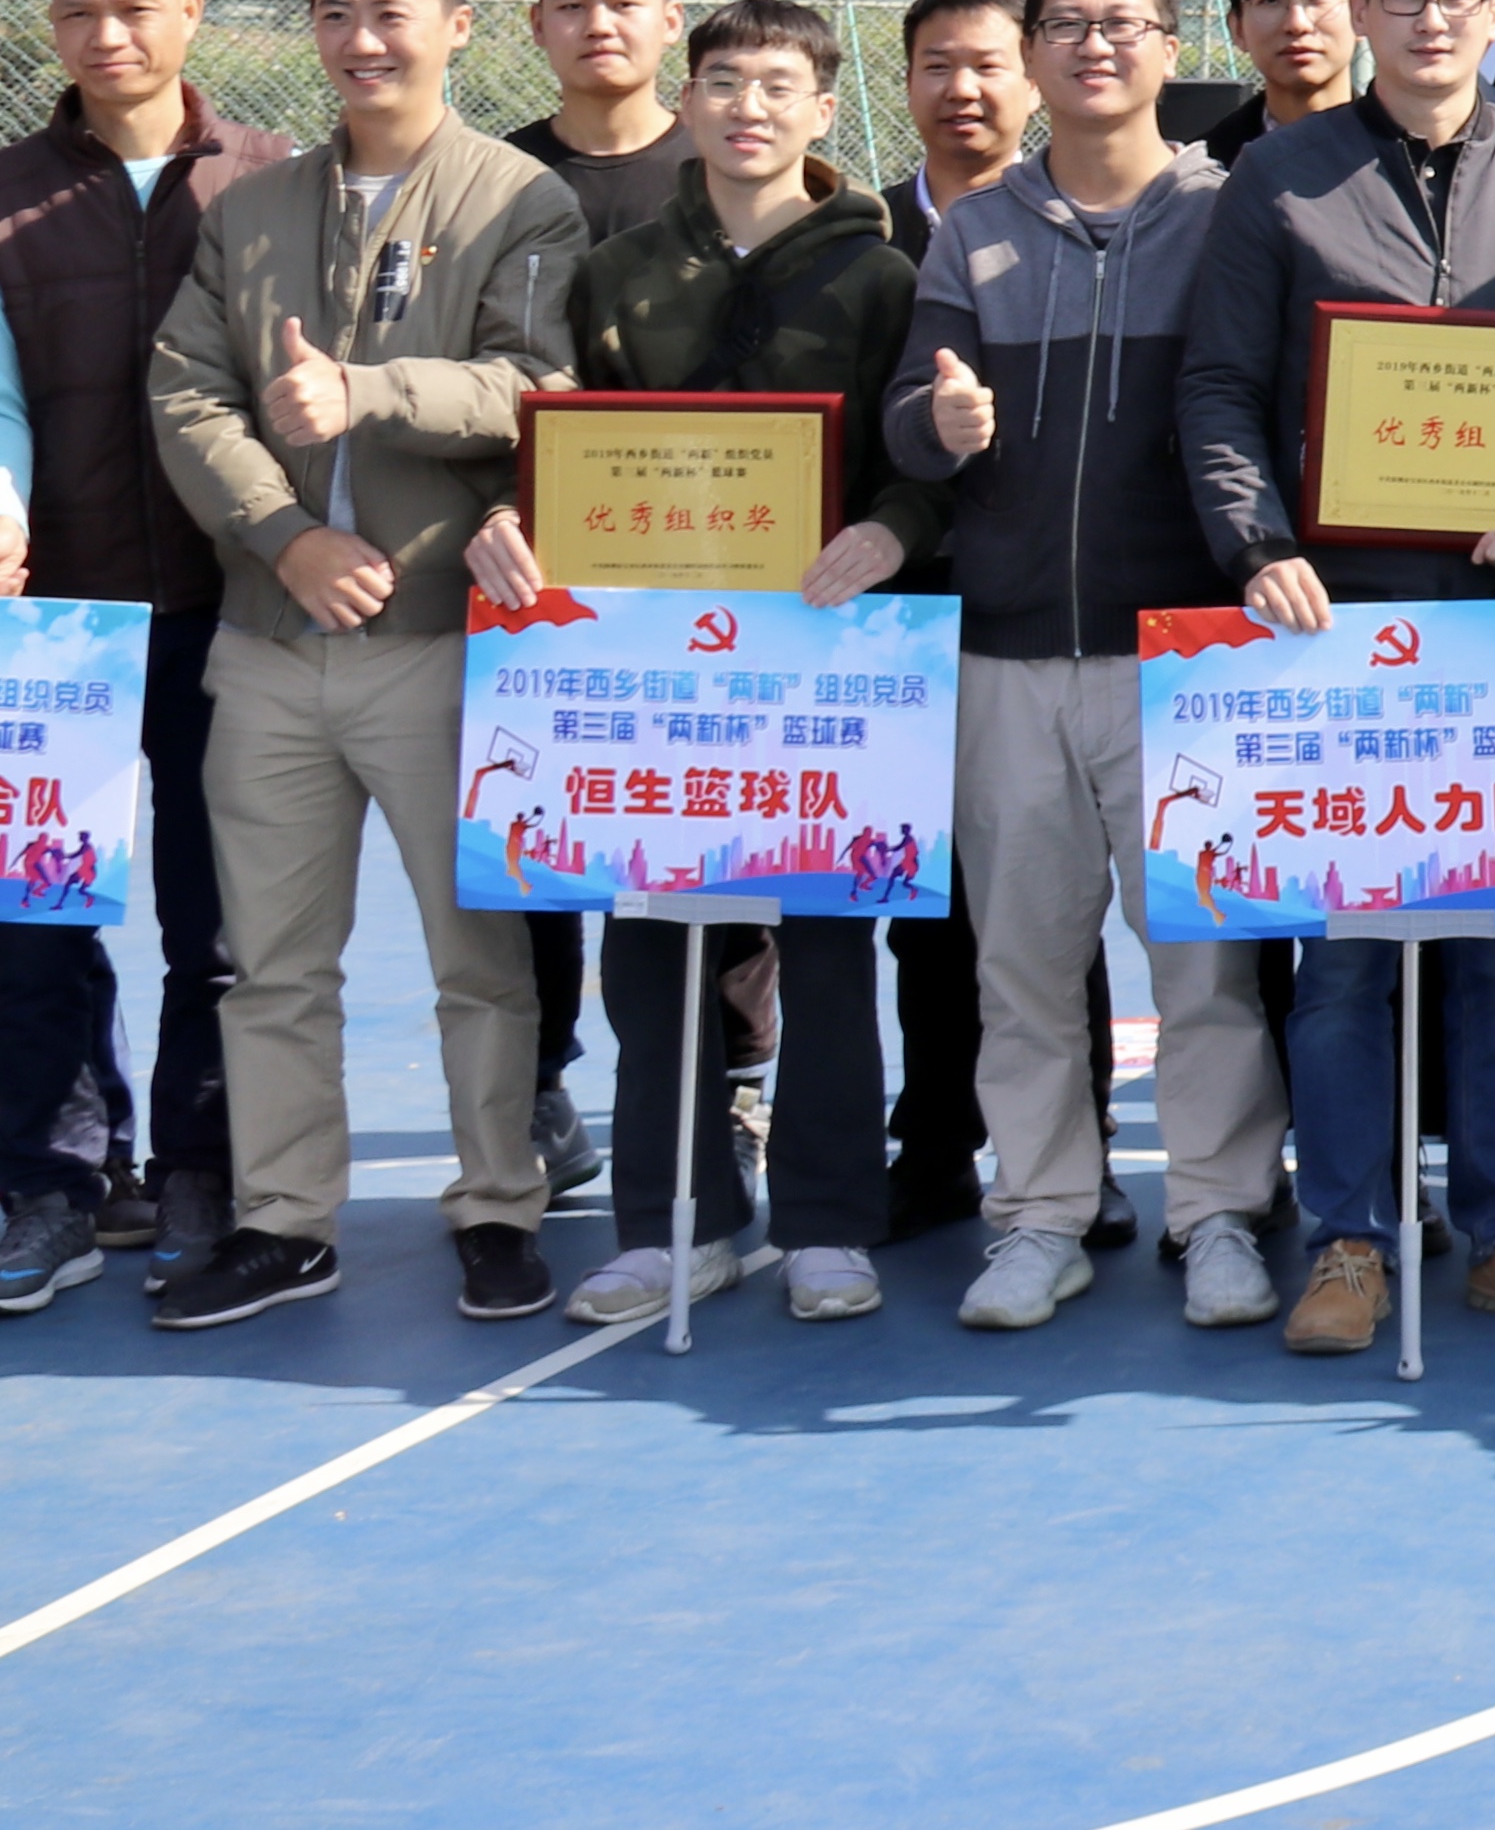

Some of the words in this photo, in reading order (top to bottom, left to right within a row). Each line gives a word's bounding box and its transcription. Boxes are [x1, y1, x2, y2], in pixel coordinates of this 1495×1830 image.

[585, 500, 776, 536] 优秀组织奖
[564, 767, 849, 822] 恒生篮球队
